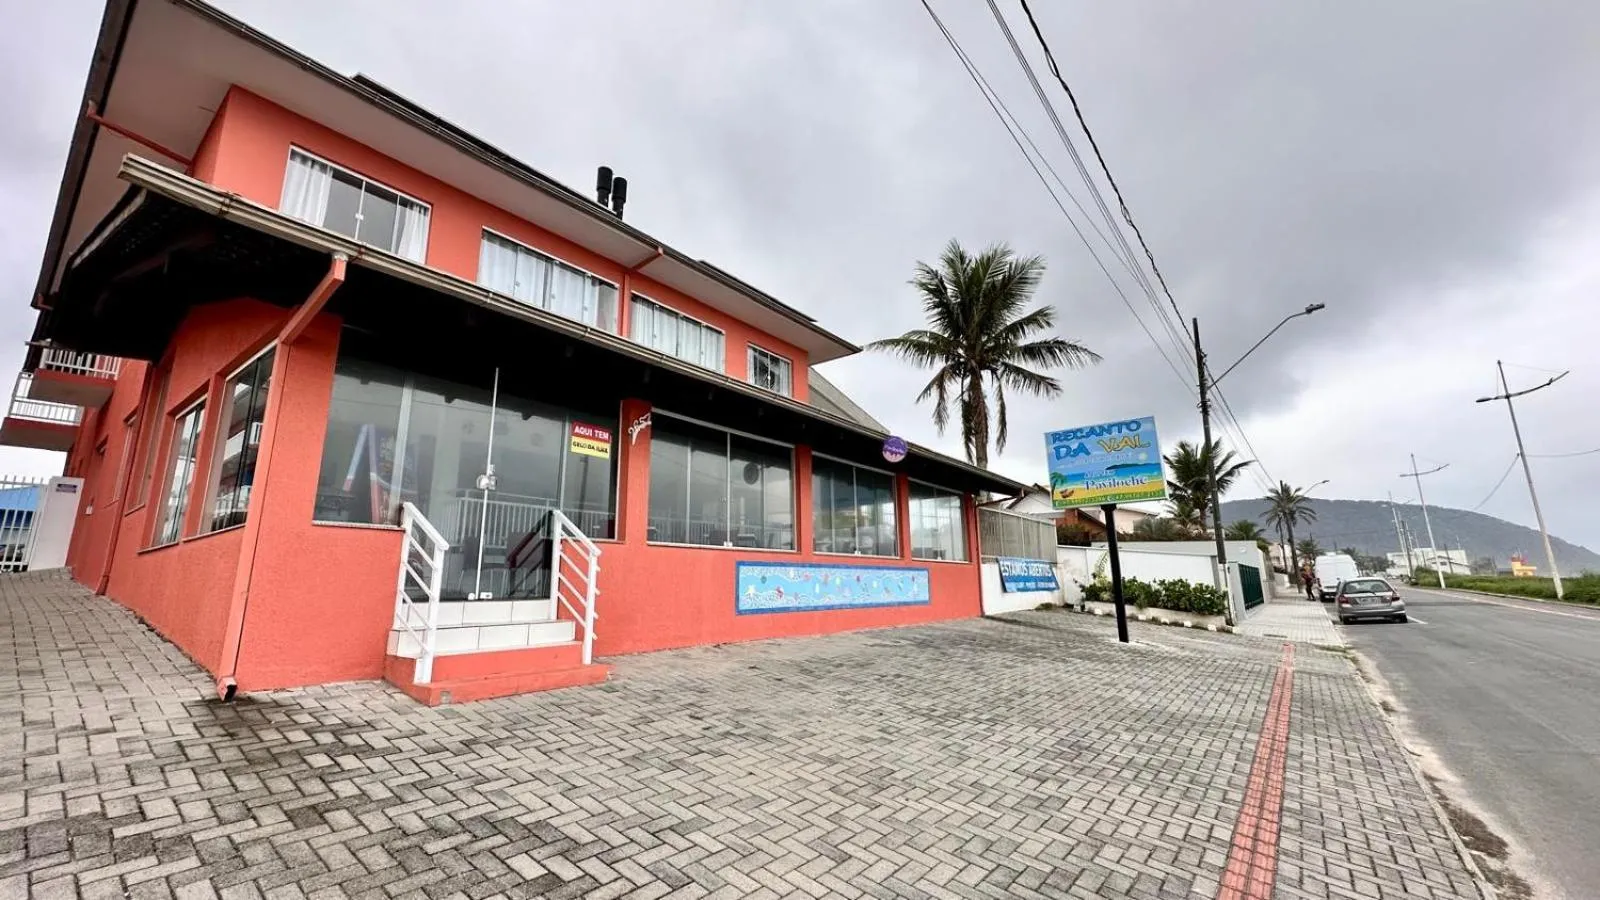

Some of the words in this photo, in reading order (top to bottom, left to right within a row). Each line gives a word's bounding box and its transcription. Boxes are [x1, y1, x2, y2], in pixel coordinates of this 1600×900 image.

[574, 425, 593, 437] AQUI
[595, 429, 609, 440] TEM
[1051, 420, 1141, 443] RECANTO
[572, 441, 587, 449] GELO
[1053, 442, 1091, 461] DA
[1097, 433, 1151, 453] VAL
[1085, 475, 1147, 491] Paviloche
